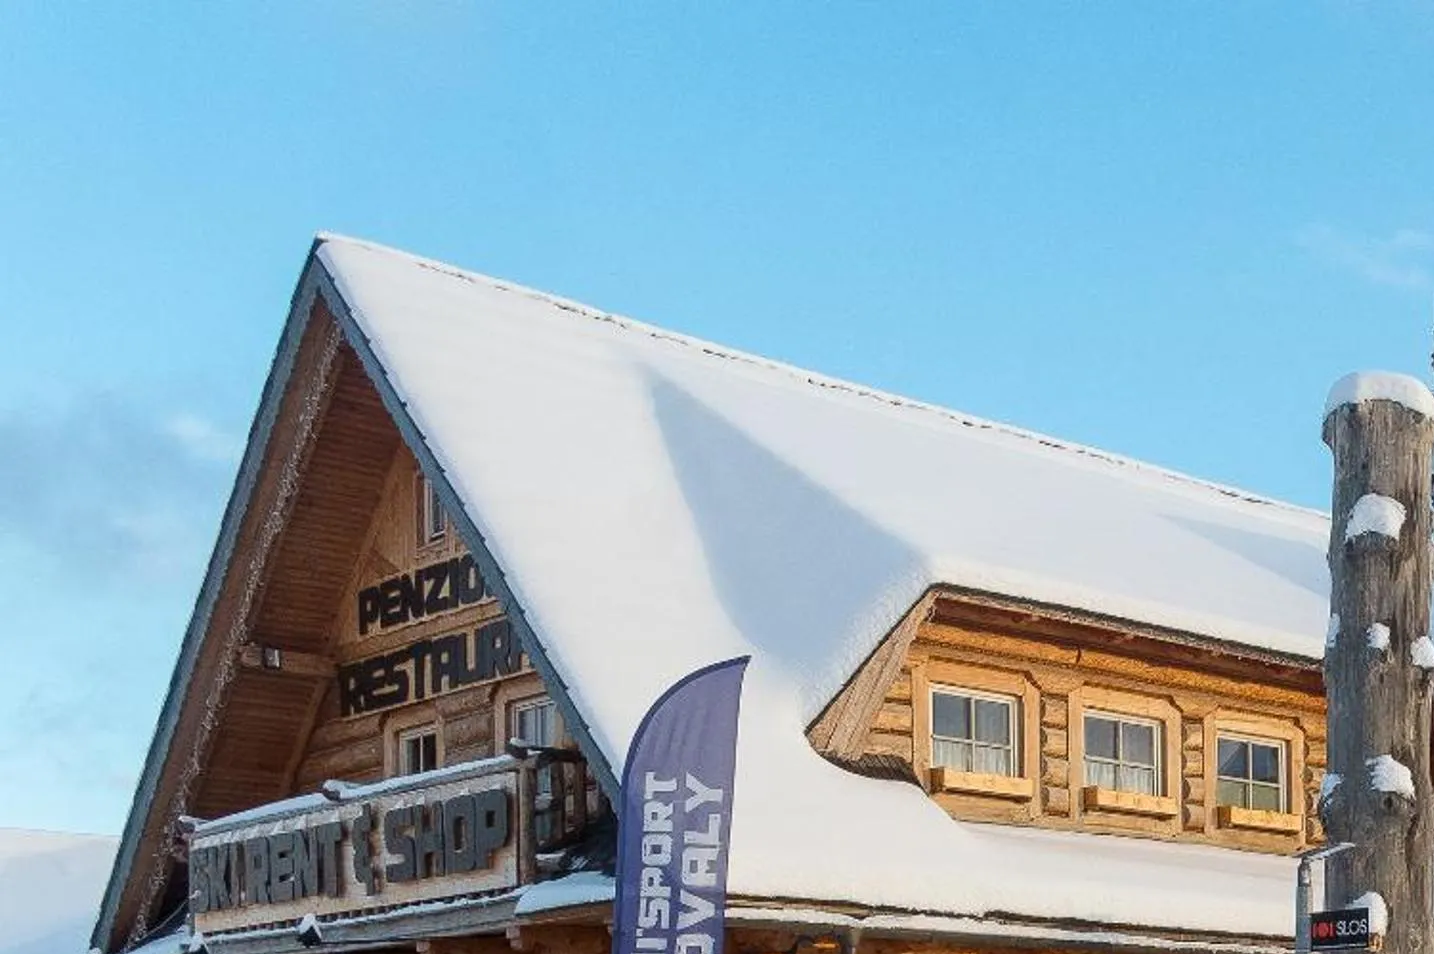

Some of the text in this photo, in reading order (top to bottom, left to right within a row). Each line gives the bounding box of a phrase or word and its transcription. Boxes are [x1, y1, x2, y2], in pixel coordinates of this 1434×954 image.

[359, 554, 490, 635] PENZIO
[189, 845, 244, 914] SKI
[243, 822, 345, 906] RENT
[384, 787, 510, 886] SHOP
